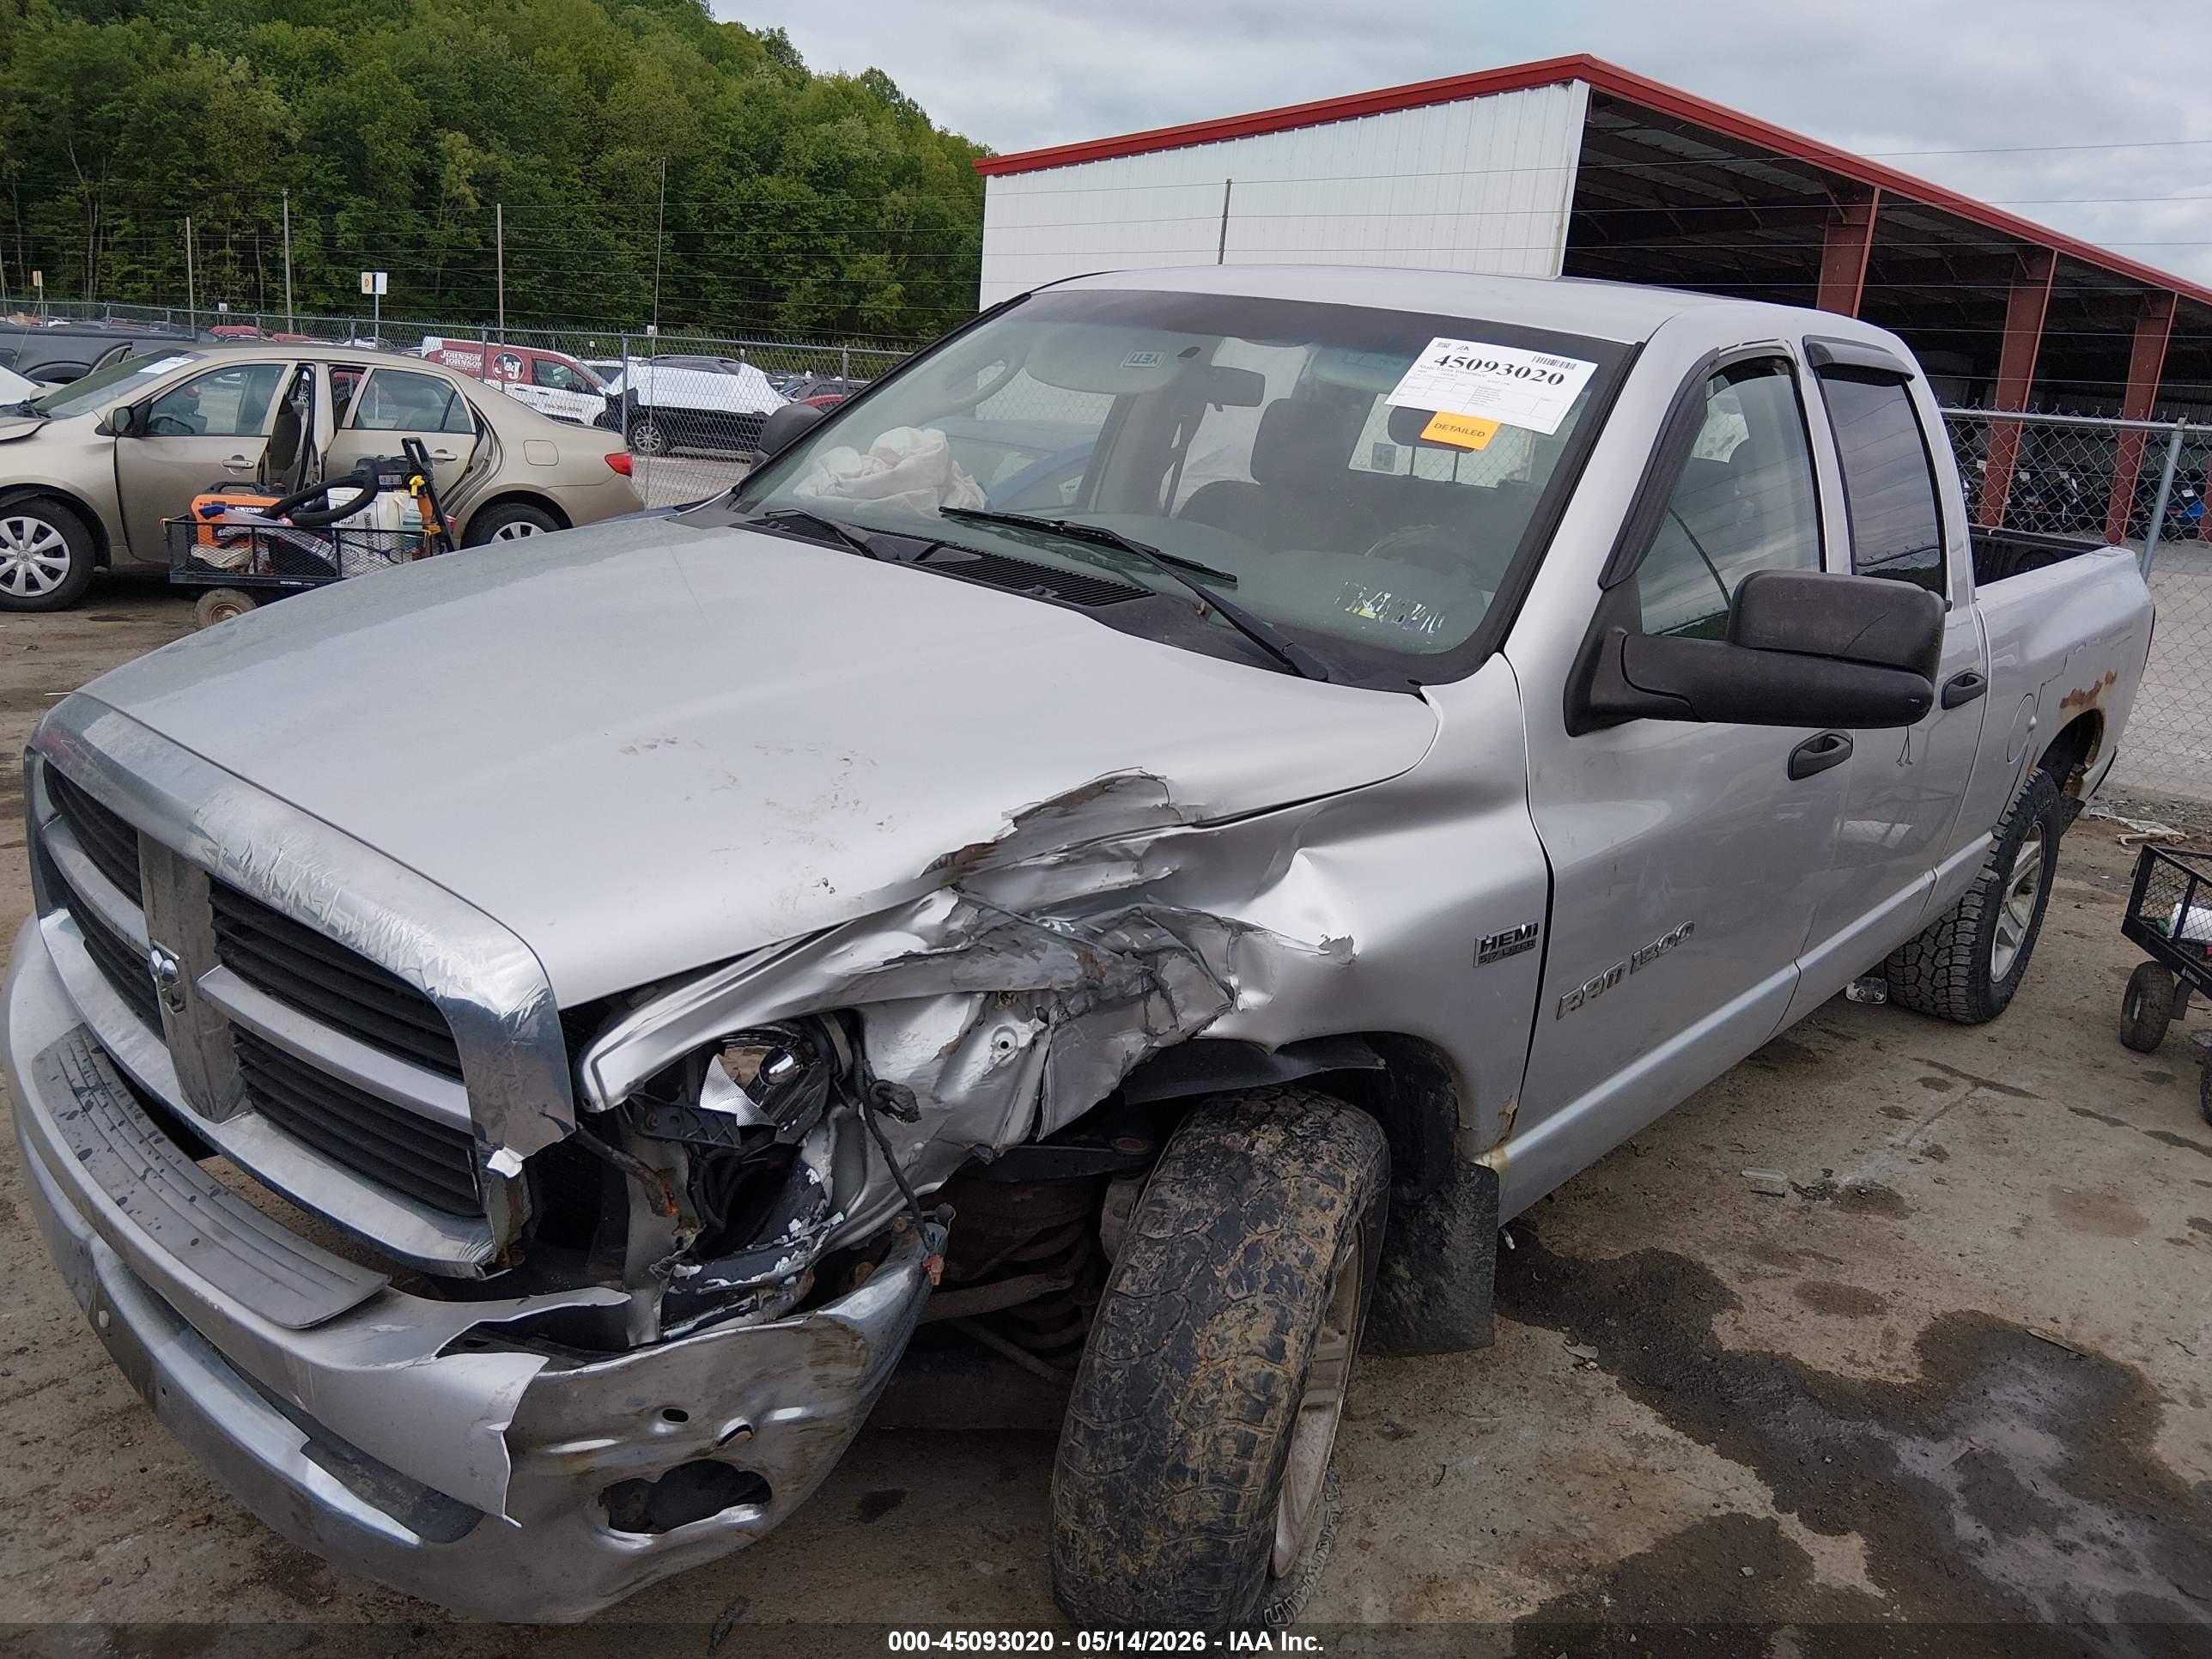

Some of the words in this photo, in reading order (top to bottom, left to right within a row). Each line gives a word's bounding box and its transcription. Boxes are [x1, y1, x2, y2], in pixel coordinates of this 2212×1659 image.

[1434, 355, 1565, 386] 45093020
[1433, 422, 1486, 438] DETAILED
[1480, 922, 1539, 954] HEMI
[1502, 938, 1536, 957] LITER
[1630, 921, 1695, 975] 1500
